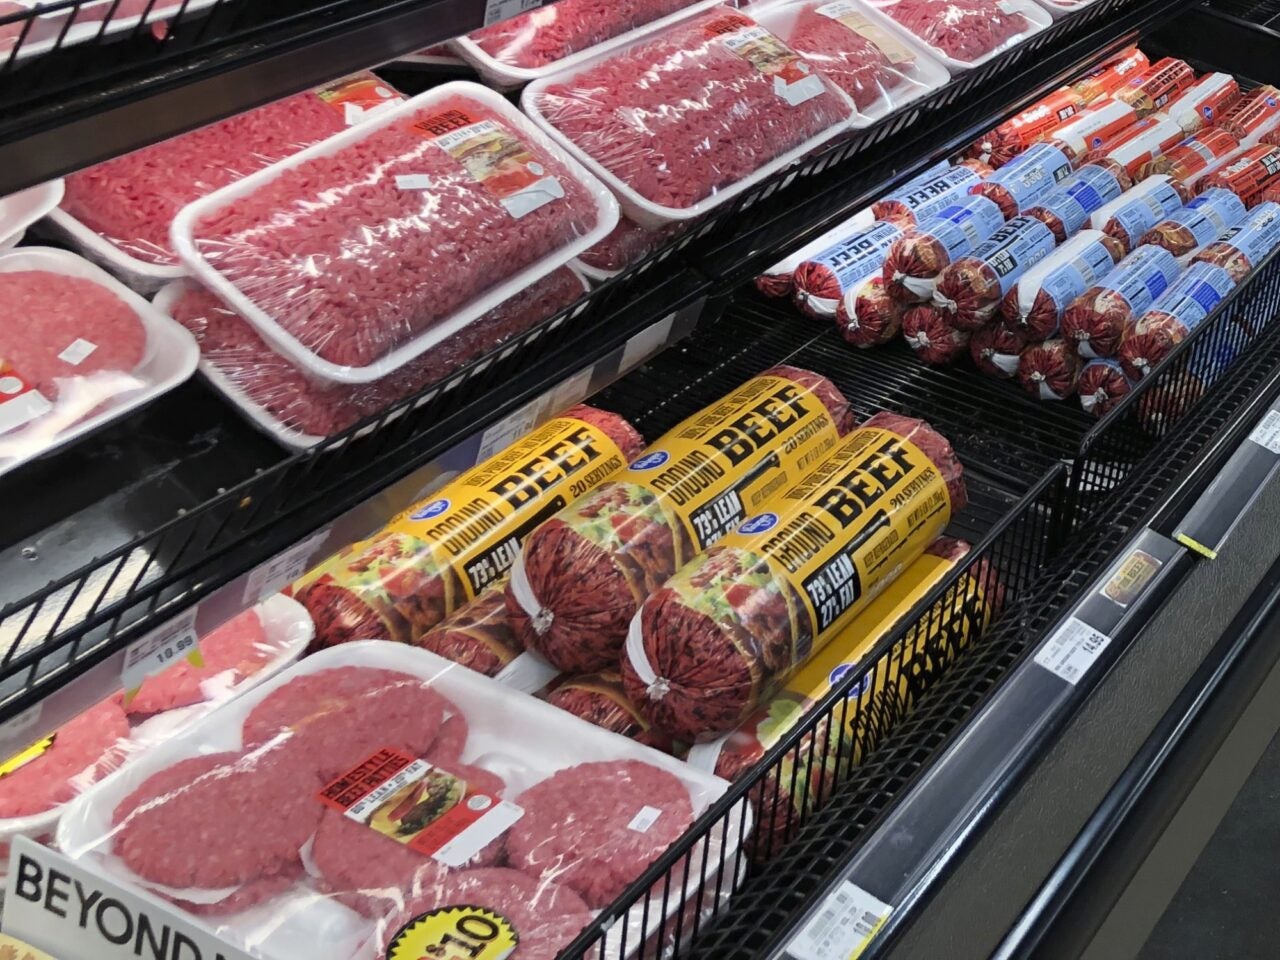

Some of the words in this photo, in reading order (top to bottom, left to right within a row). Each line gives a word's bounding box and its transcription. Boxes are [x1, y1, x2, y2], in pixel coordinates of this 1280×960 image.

[428, 115, 472, 136] BEEF
[906, 179, 951, 210] BEEF
[988, 215, 1031, 242] BEEF
[650, 449, 725, 506] GROUND
[703, 384, 810, 468] BEEF
[781, 436, 798, 454] 20
[797, 413, 829, 445] SERVINGS
[426, 497, 506, 556] GROUND
[486, 426, 603, 511] BEEF
[569, 479, 588, 499] 20
[586, 454, 623, 488] SERVINGS
[889, 491, 905, 509] 20
[902, 467, 936, 502] SERVINGS
[693, 511, 716, 540] 73%
[714, 489, 743, 526] LEAN
[761, 511, 836, 574] GROUND
[812, 437, 916, 530] BEEF
[468, 561, 495, 589] 73%
[806, 575, 831, 607] 73%
[829, 552, 856, 589] LEAN
[820, 597, 841, 628] 27%
[840, 579, 856, 611] FAT
[320, 749, 395, 799] HOMESTYLE
[361, 754, 409, 787] PATTIES
[365, 786, 389, 803] LEAN
[405, 761, 422, 774] FAT
[15, 853, 203, 960] BEYOND
